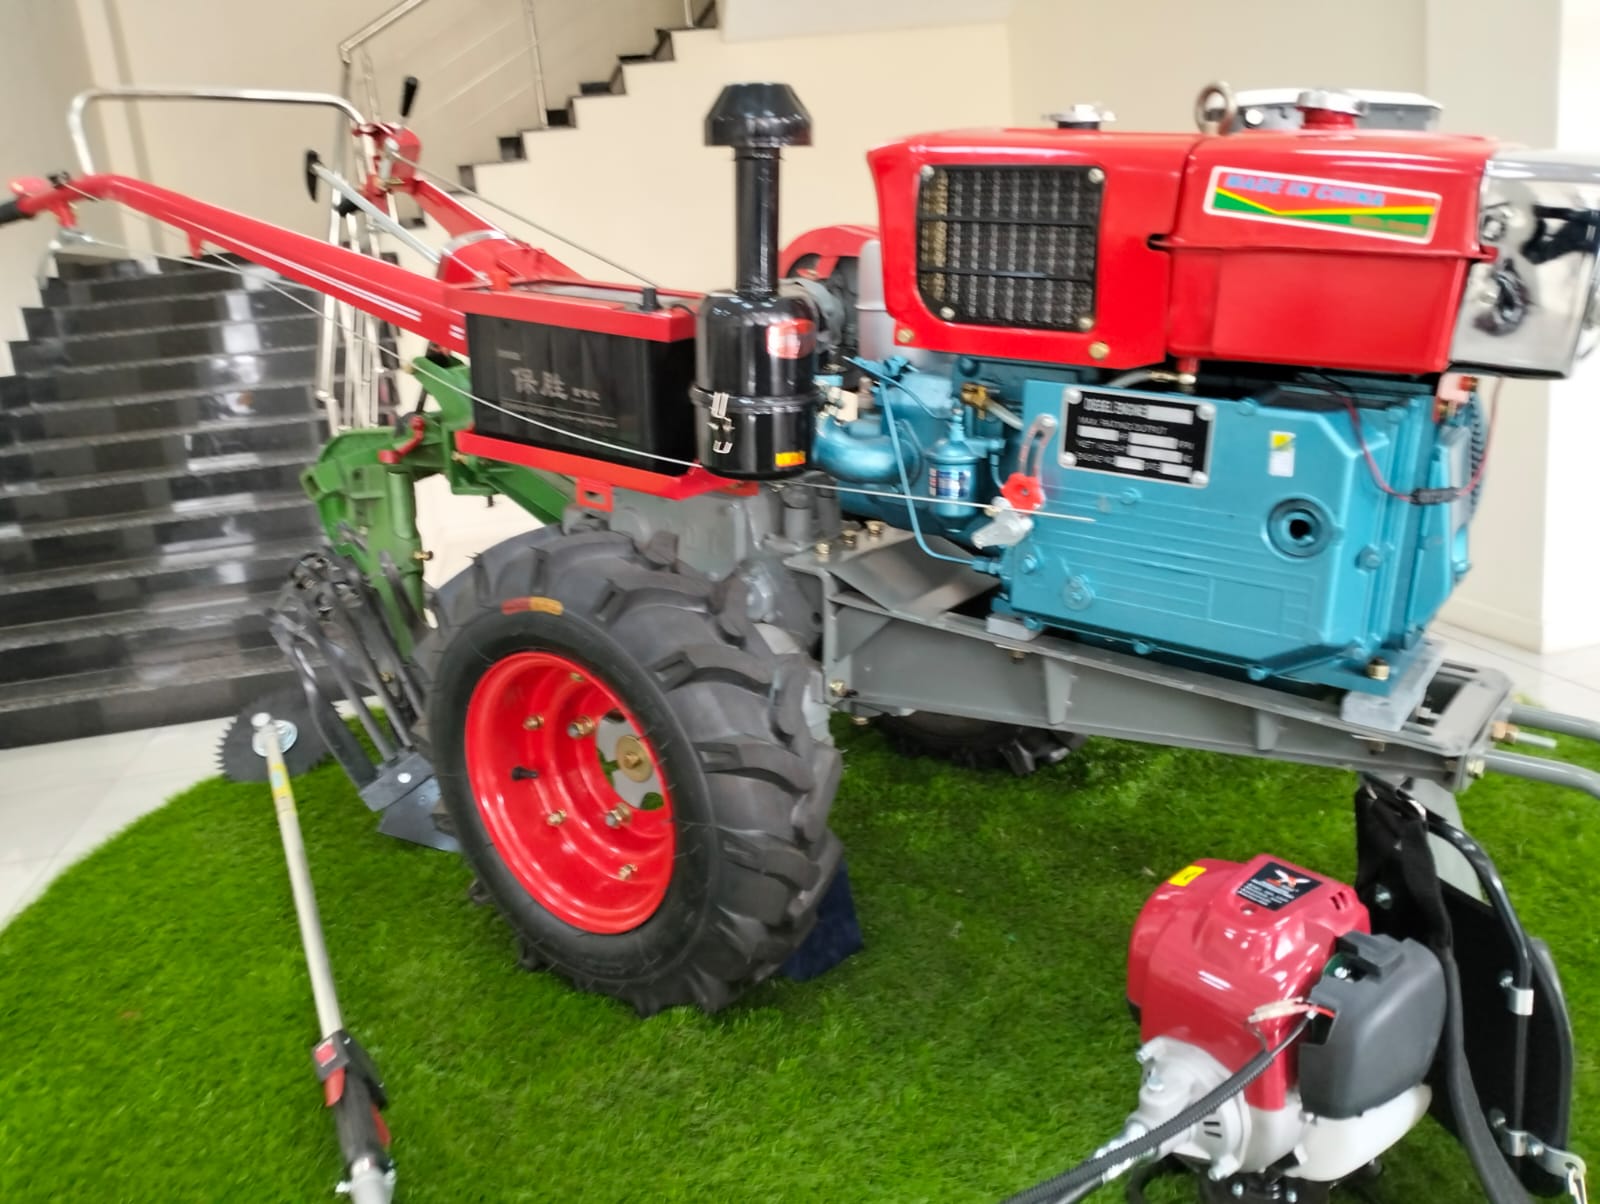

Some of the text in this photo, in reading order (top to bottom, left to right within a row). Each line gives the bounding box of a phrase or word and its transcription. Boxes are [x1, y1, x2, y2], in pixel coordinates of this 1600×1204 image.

[1223, 174, 1386, 208] MADE IN CHINA
